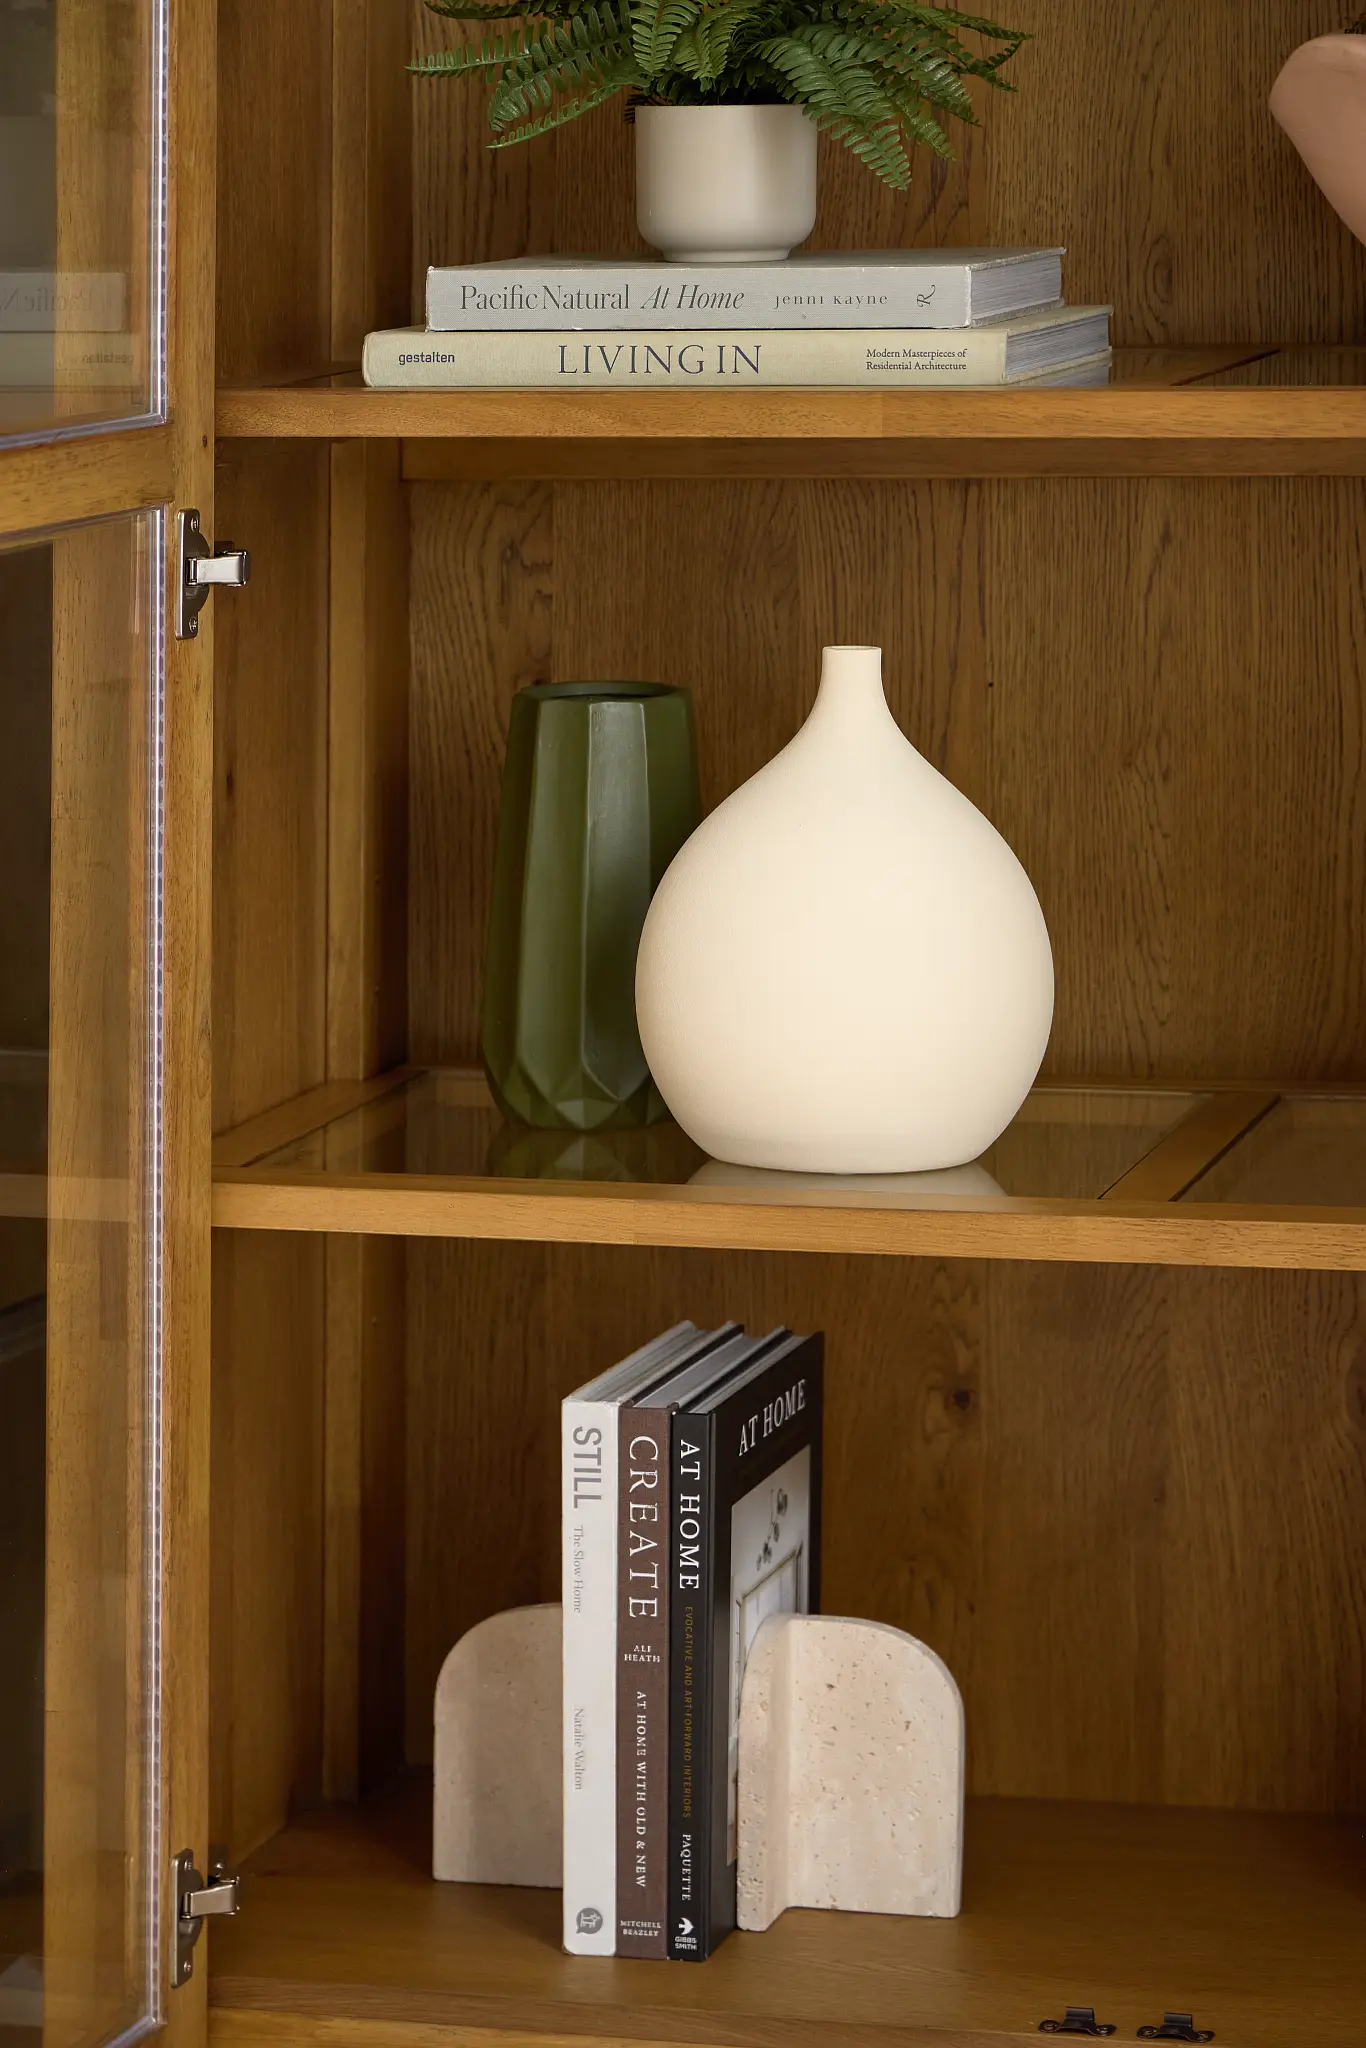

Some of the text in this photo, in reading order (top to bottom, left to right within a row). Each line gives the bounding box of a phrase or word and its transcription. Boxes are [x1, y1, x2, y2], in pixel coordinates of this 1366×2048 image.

[461, 284, 745, 310] Pacific Natural At Home
[398, 352, 456, 366] gestalten
[557, 344, 762, 375] LIVING IN
[866, 348, 968, 361] Modern Masterpieces of
[866, 361, 967, 371] Residential Architecture
[738, 1378, 807, 1457] AT HOME
[572, 1425, 603, 1510] STILL
[628, 1435, 659, 1618] CREATE
[679, 1438, 701, 1590] AT HOME
[573, 1525, 584, 1613] The Slow Home
[623, 1653, 661, 1663] HEATH
[633, 1644, 652, 1653] ALI
[683, 1606, 693, 1818] EVOCATIVE AND ART-FORWARD INTERIORS
[573, 1708, 586, 1790] Natalie Walton
[635, 1690, 647, 1888] AT HOME WITH OLD & NEW
[680, 1833, 692, 1901] PAQUETTE
[620, 1919, 662, 1929] MITCHELL
[622, 1929, 660, 1937] BEAZLEY
[674, 1936, 697, 1944] GIBBS
[674, 1943, 698, 1951] SMITH
